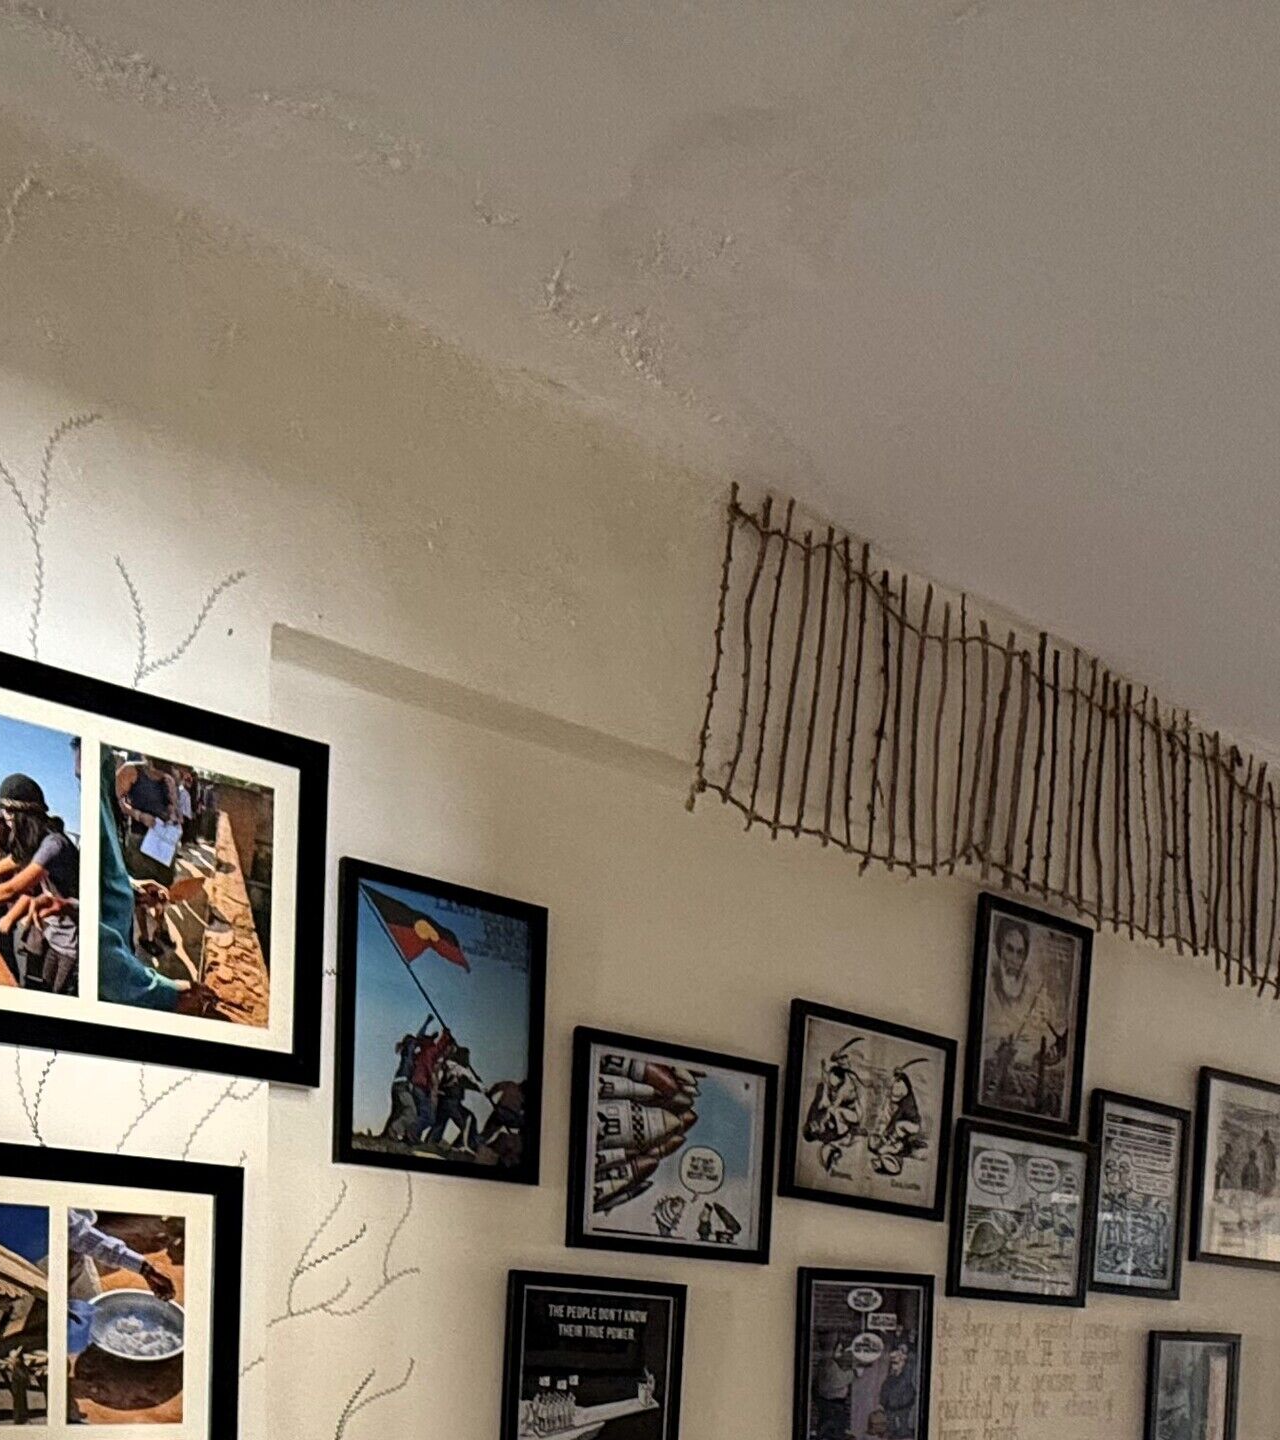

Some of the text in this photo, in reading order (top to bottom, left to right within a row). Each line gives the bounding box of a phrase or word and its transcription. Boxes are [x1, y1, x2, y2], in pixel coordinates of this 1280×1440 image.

[548, 1304, 565, 1318] THE
[566, 1305, 597, 1320] PEOPLE
[558, 1323, 583, 1337] THEIR
[584, 1325, 605, 1339] TRUE
